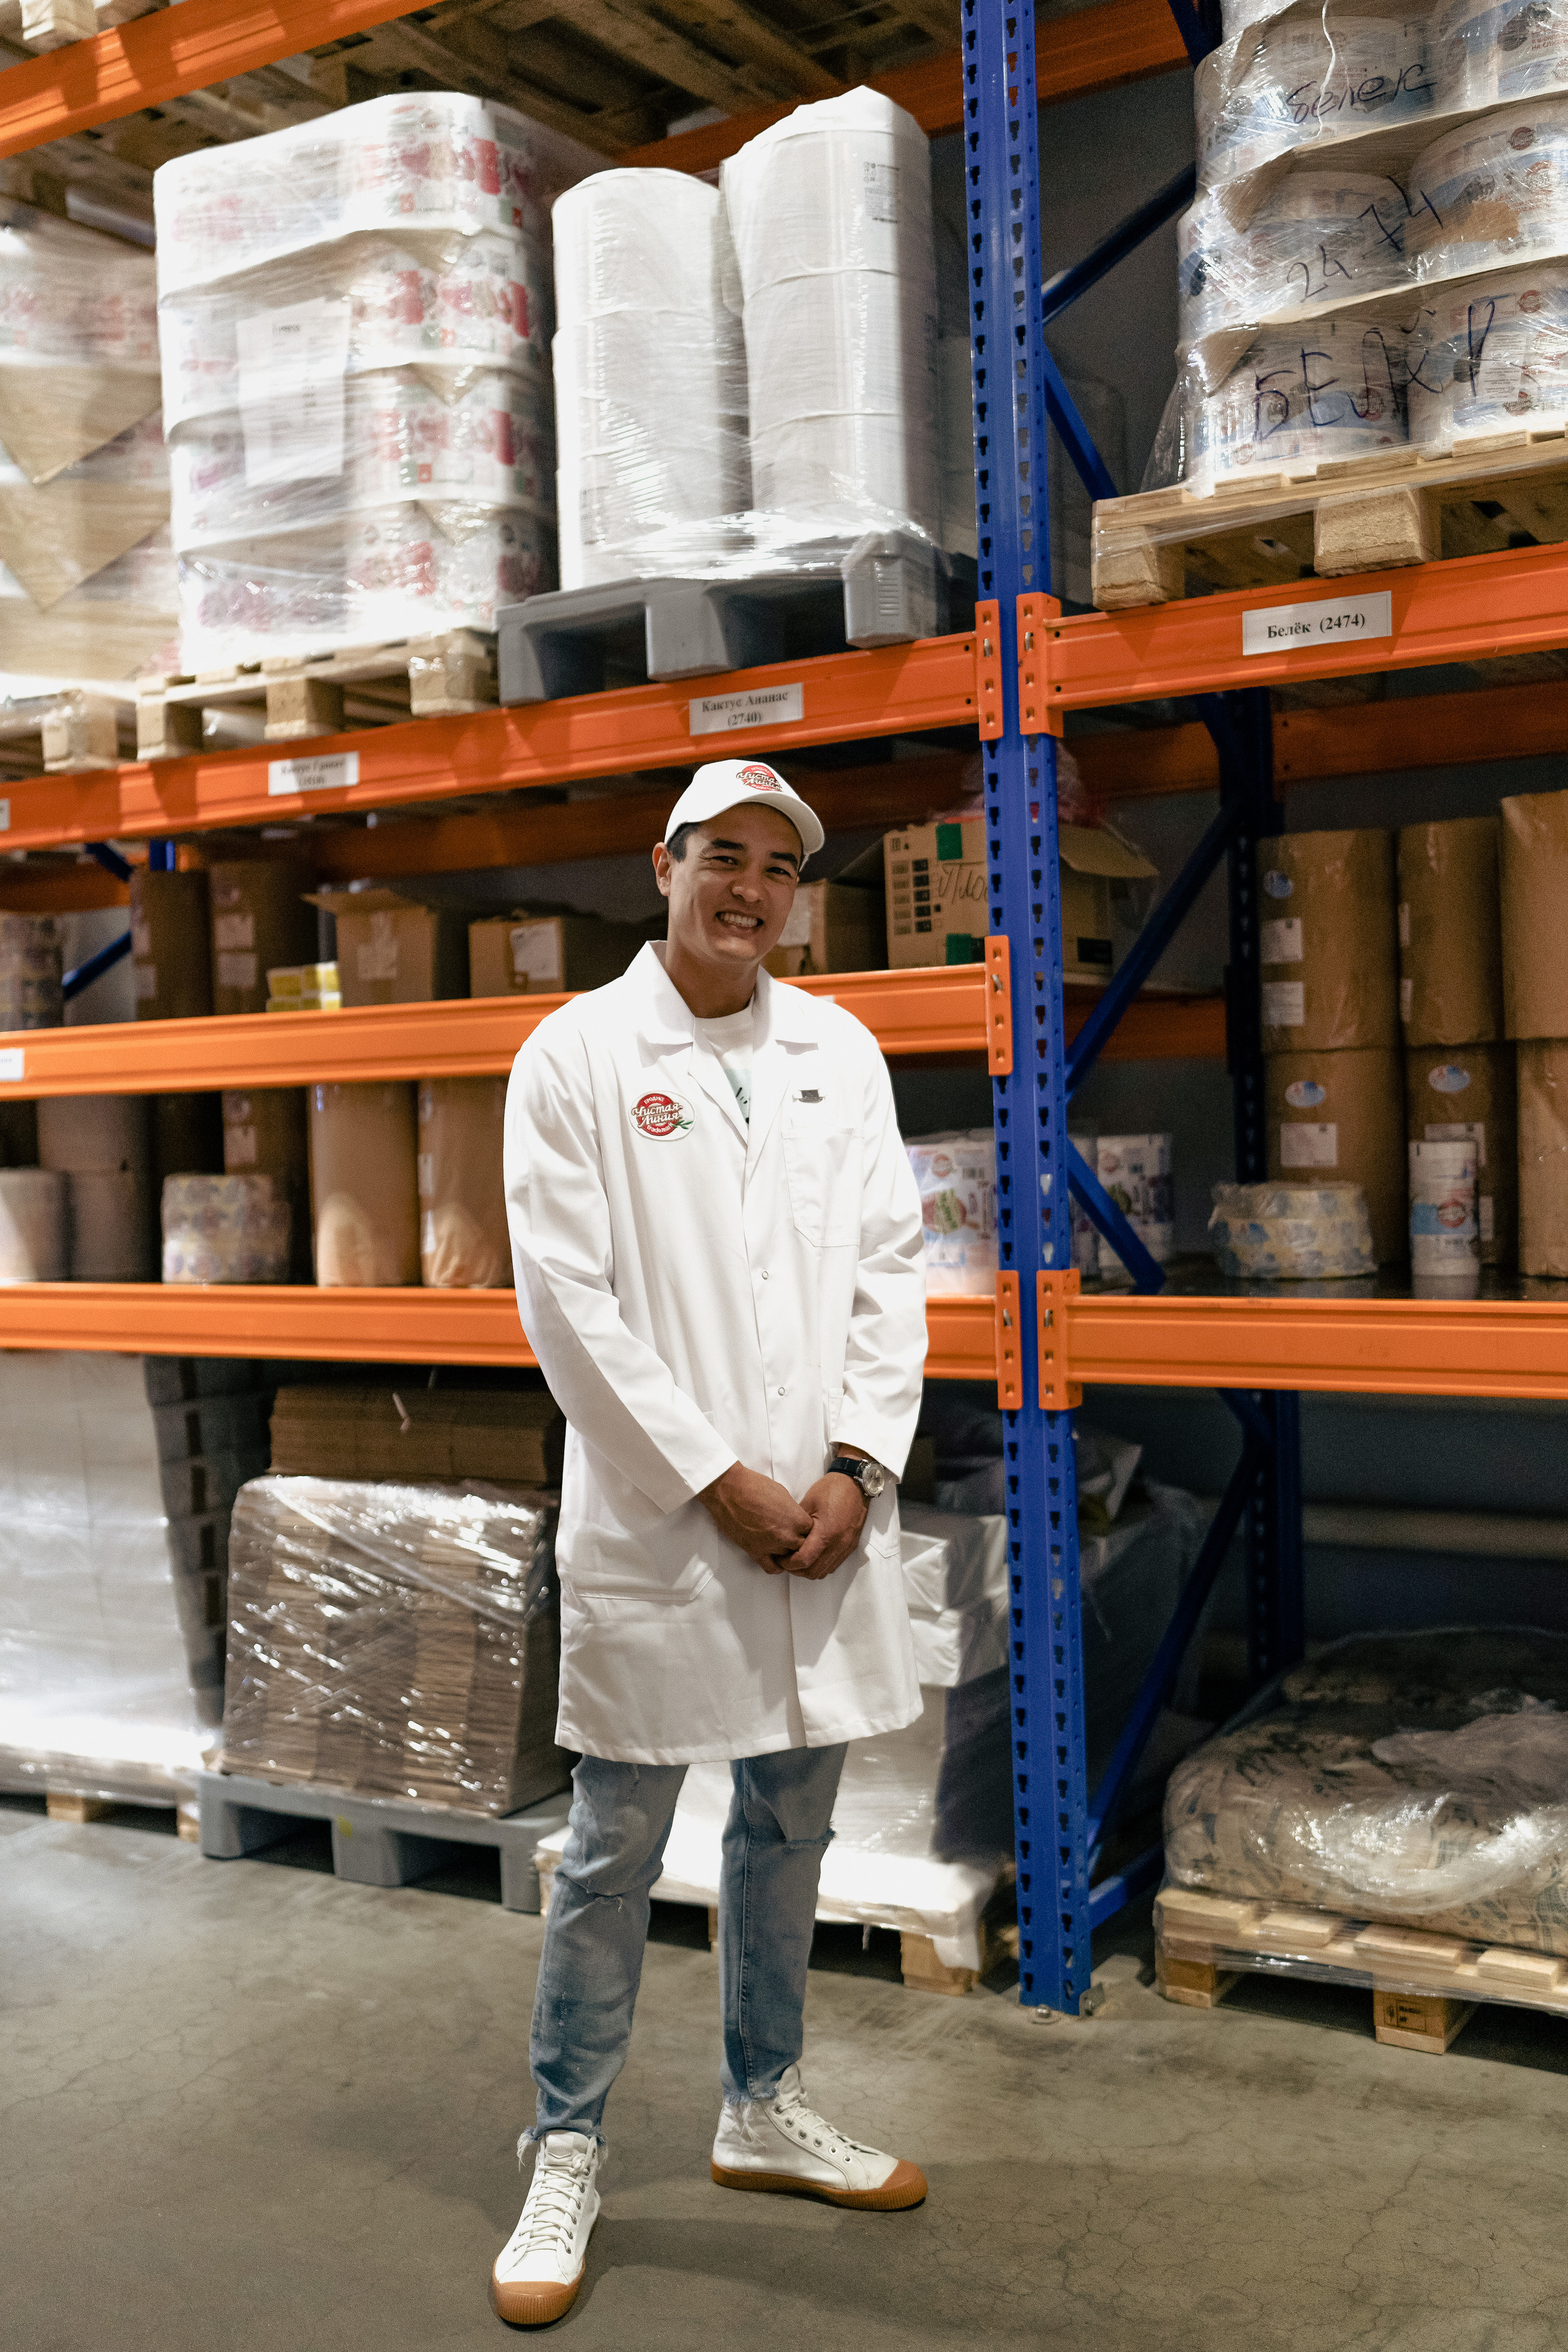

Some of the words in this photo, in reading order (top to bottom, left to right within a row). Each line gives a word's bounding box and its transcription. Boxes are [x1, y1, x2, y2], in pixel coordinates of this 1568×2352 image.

[1267, 622, 1311, 638] Белёк
[1319, 613, 1365, 633] (2474)
[702, 698, 742, 712] Кактус
[745, 692, 788, 706] Ананас
[727, 711, 762, 729] (2740)
[644, 1096, 665, 1104] ПРОДУКТ
[631, 1102, 684, 1117] Чистая
[638, 1112, 683, 1128] Линия
